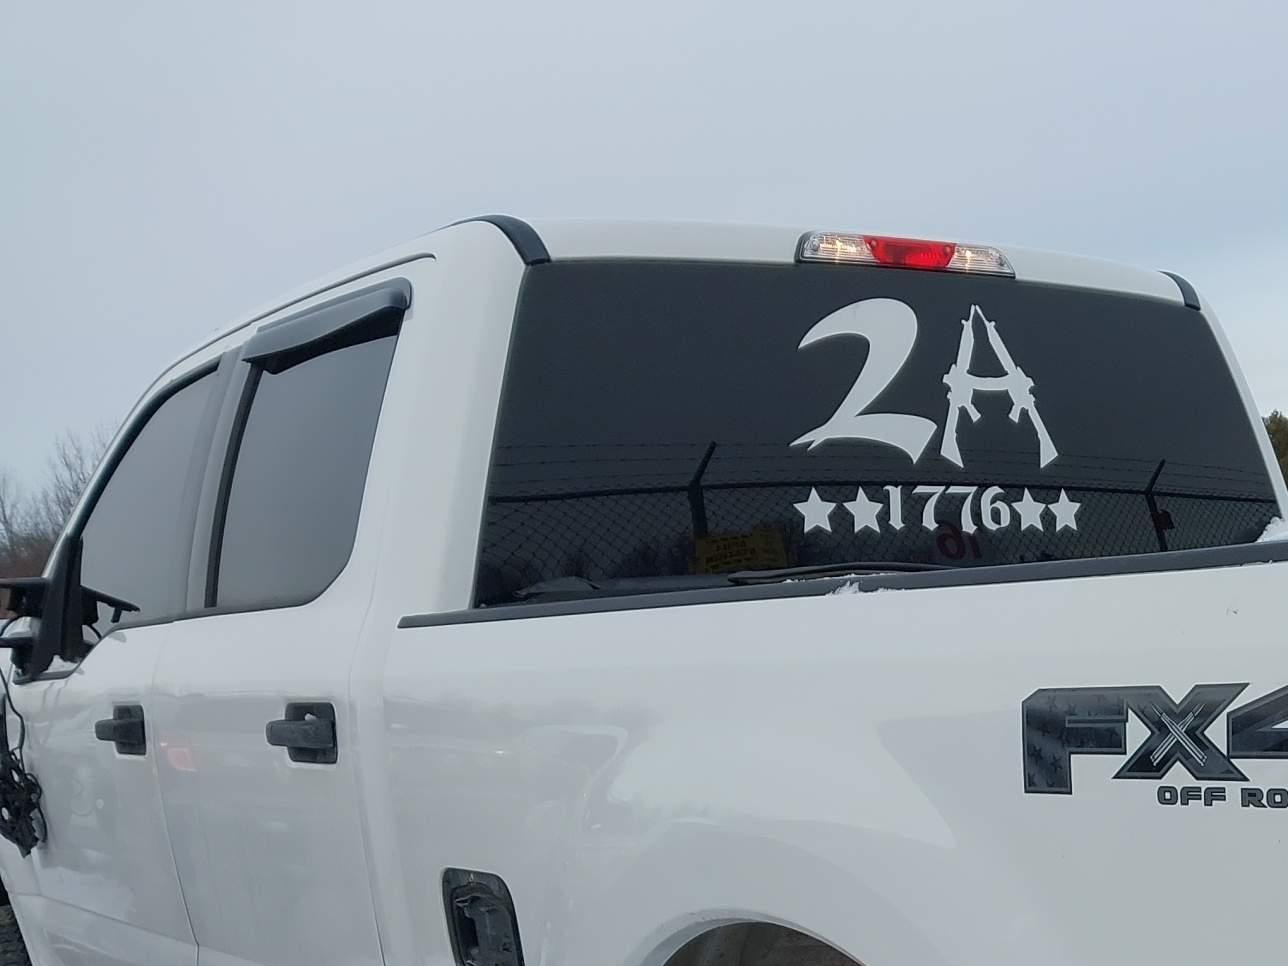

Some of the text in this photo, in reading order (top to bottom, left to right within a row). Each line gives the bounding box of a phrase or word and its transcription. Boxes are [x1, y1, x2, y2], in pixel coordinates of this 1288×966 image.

[789, 297, 1059, 468] 2A
[884, 485, 1011, 534] 1776
[1156, 785, 1227, 807] OFF
